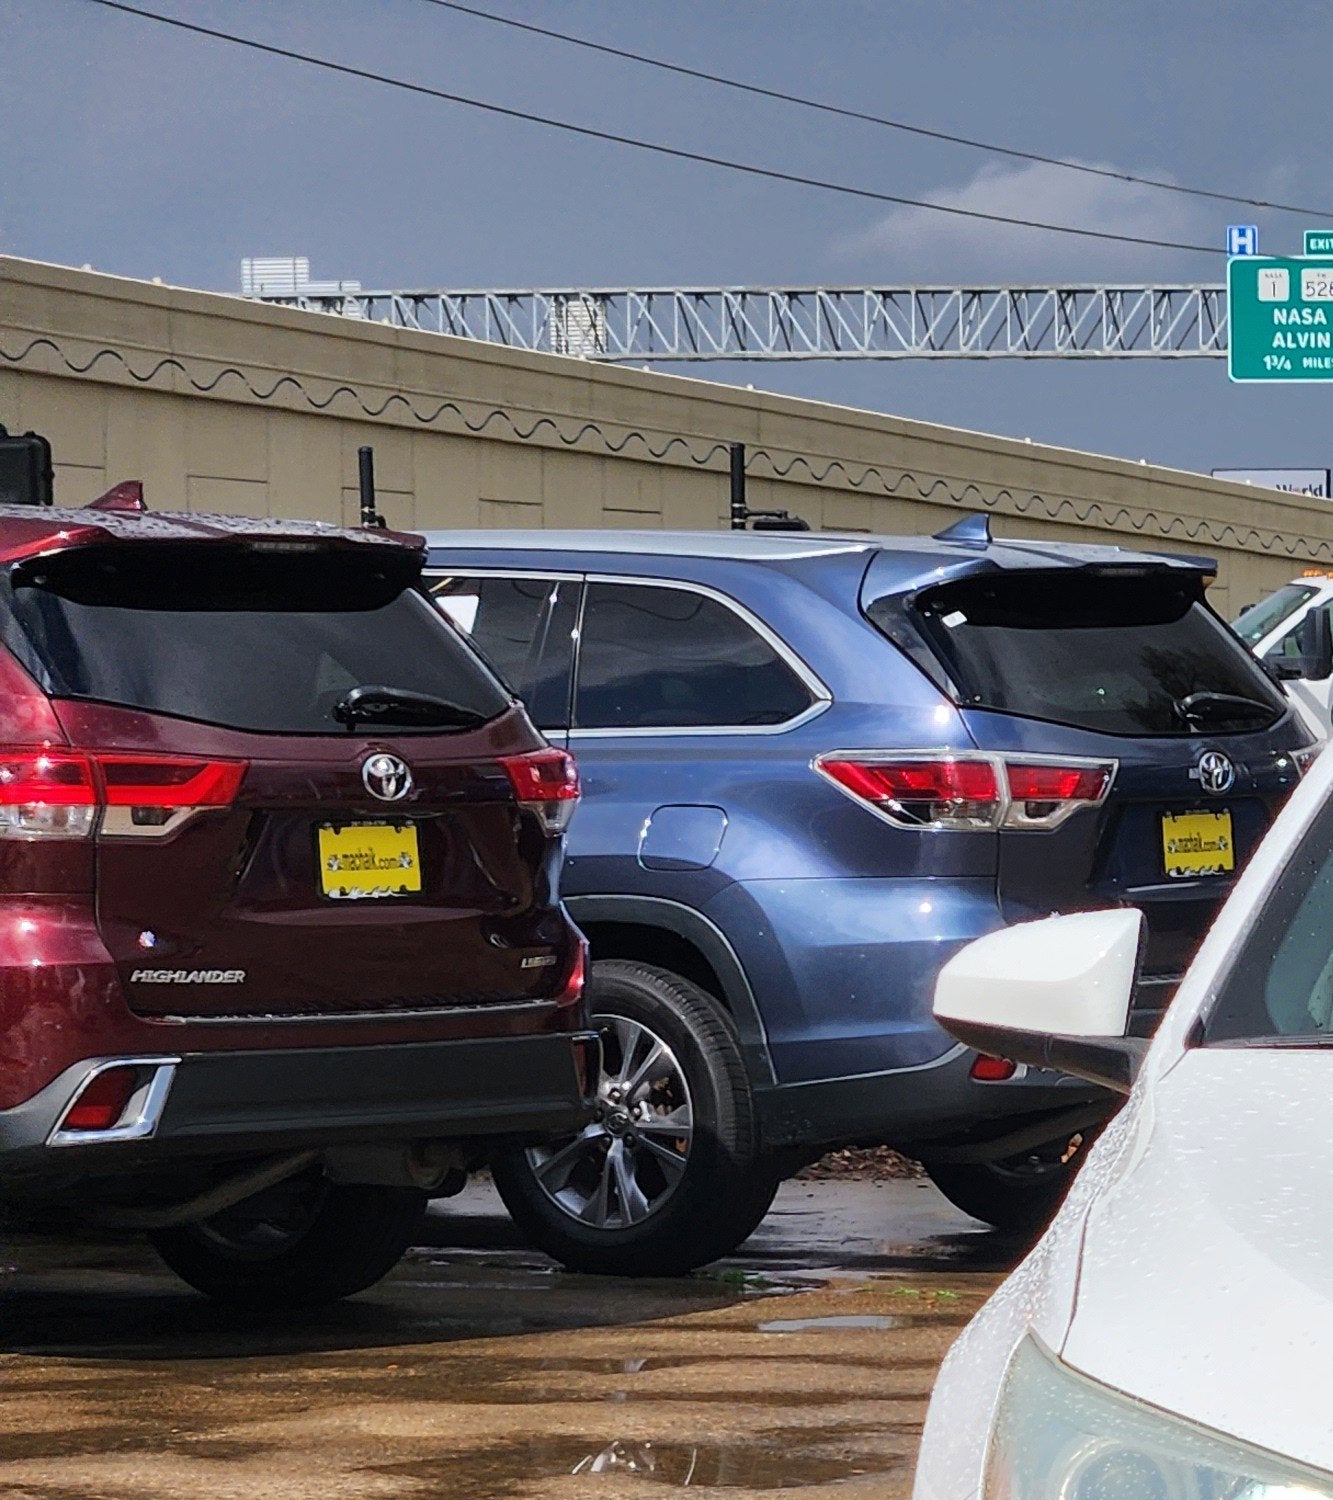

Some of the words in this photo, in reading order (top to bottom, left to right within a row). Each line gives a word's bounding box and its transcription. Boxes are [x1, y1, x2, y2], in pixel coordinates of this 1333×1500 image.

[1231, 228, 1253, 254] H
[1273, 307, 1327, 326] NASA
[1271, 331, 1331, 349] ALVIN
[130, 970, 246, 983] HIGHLANDER
